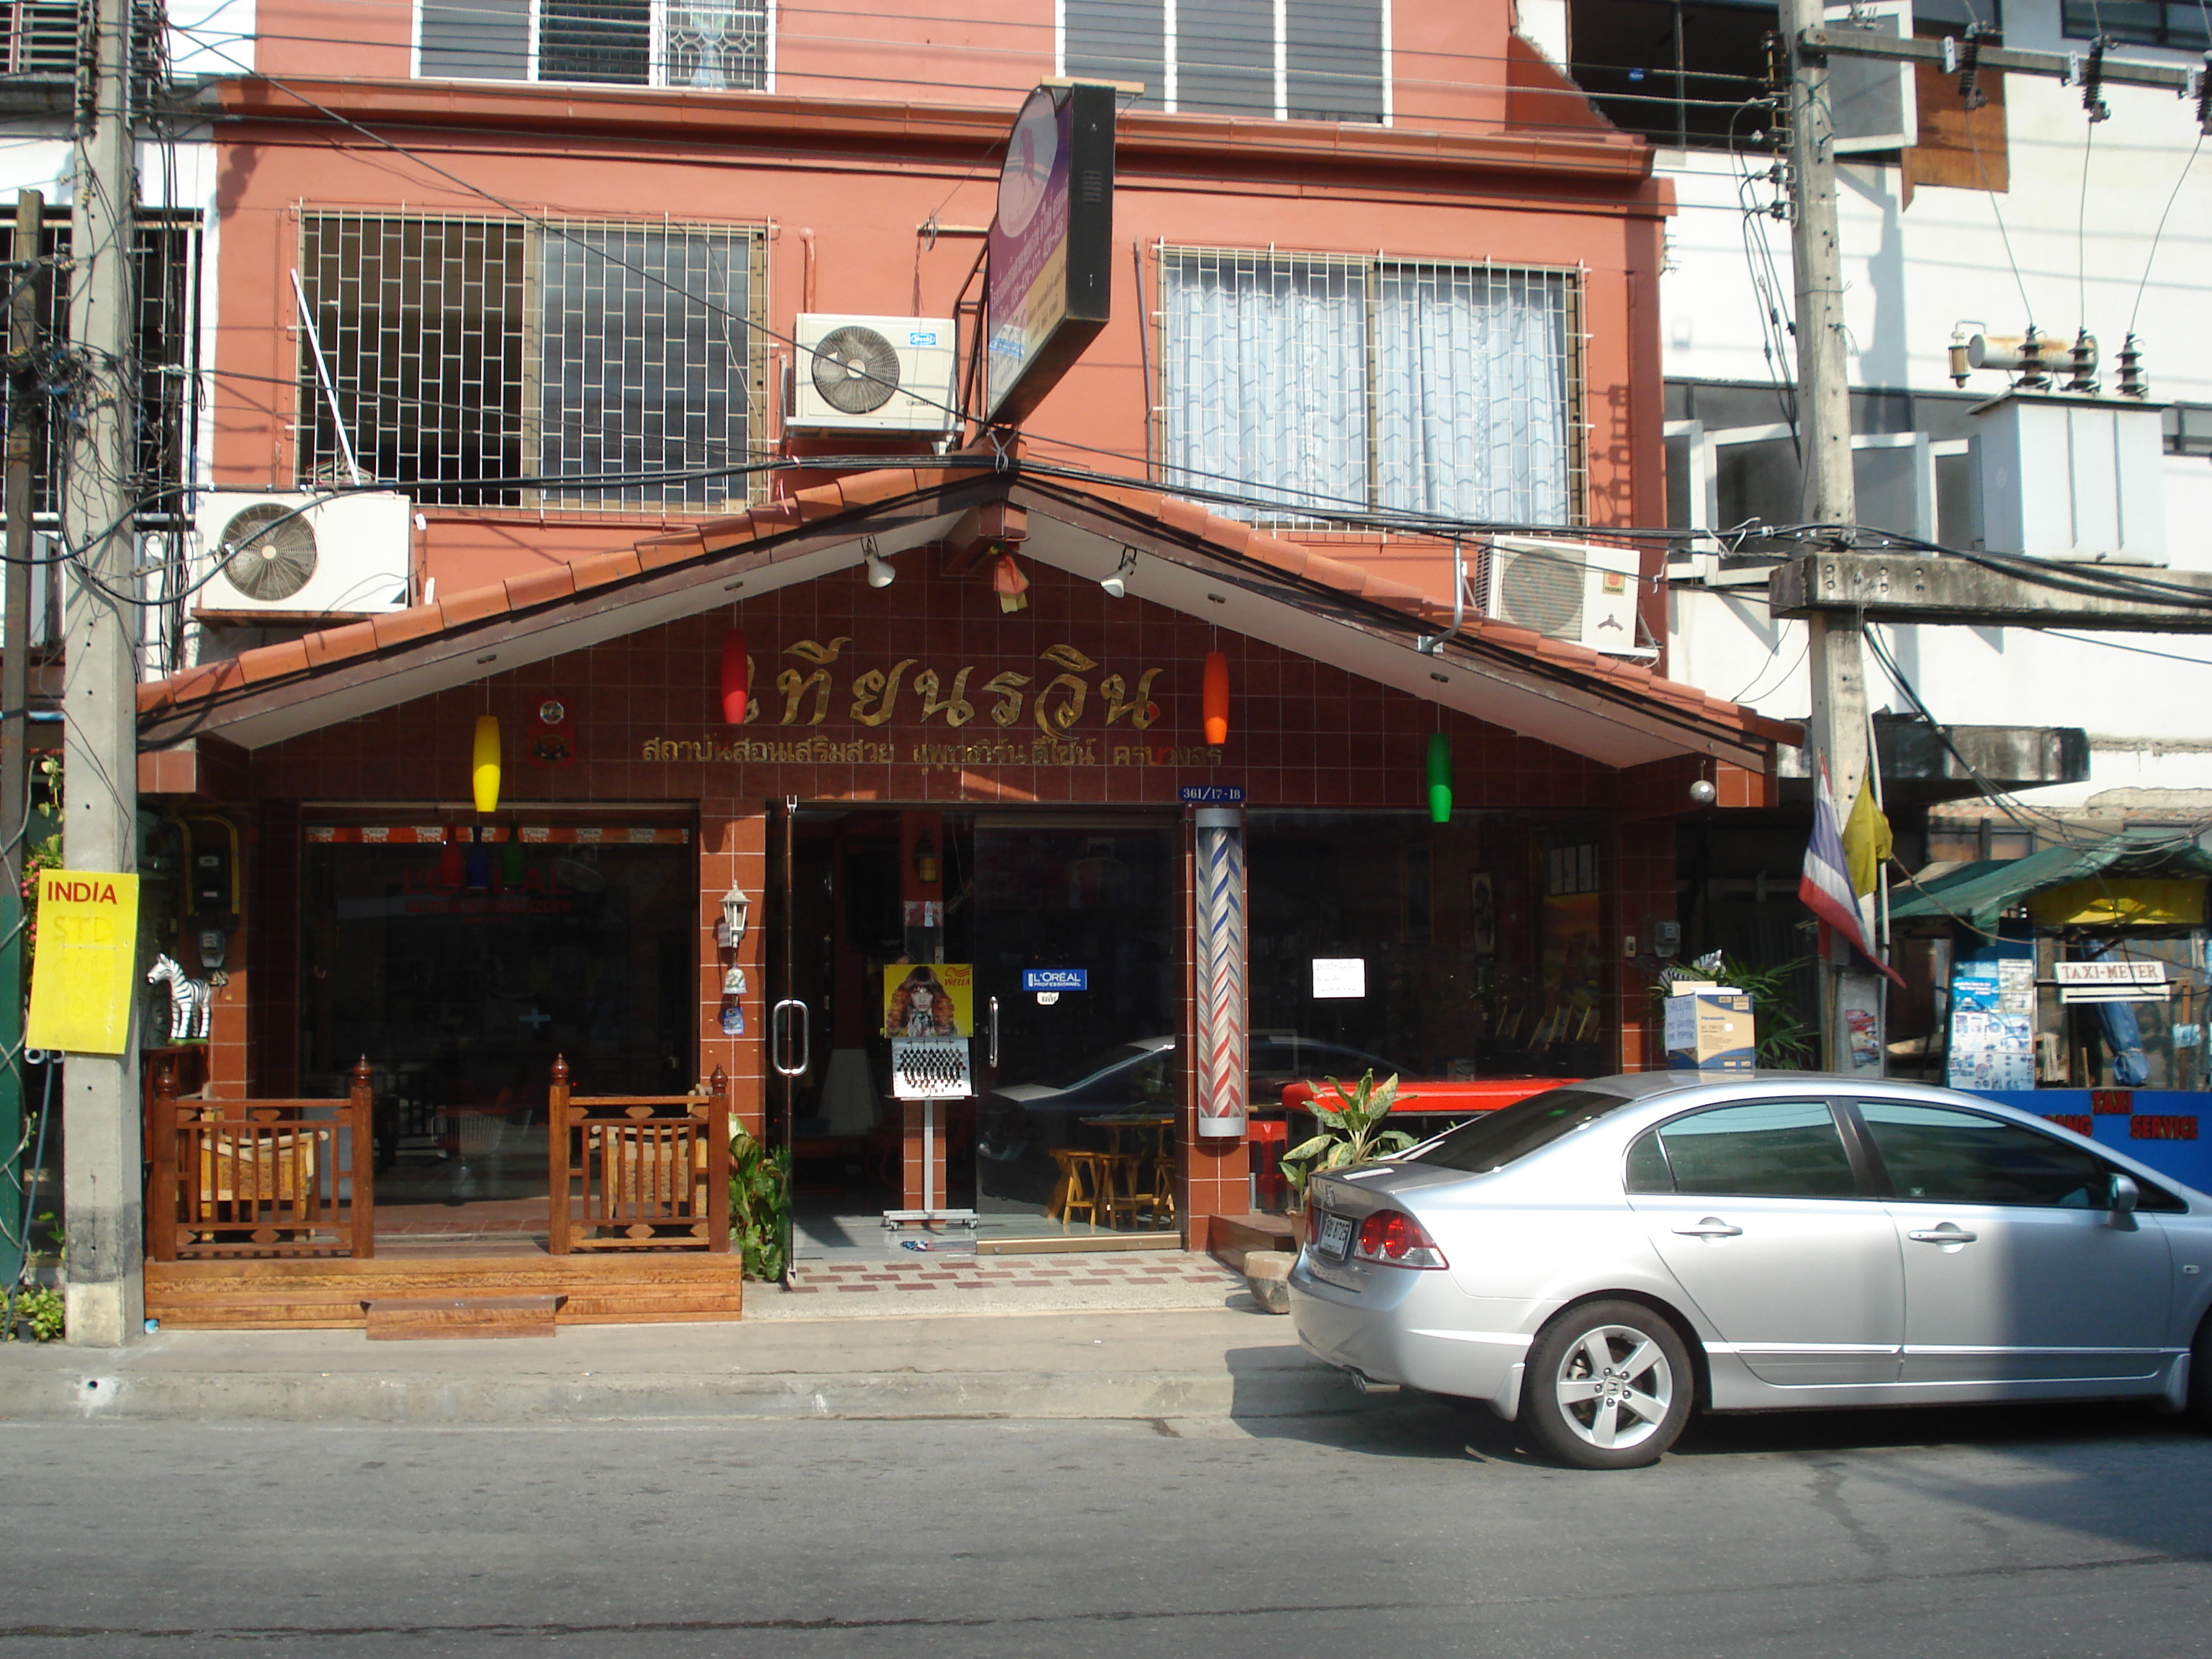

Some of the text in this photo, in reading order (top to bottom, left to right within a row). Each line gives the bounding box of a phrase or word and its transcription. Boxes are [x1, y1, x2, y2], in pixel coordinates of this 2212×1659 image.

[1183, 786, 1241, 800] 361/17-18
[48, 881, 117, 904] INDIA
[1033, 972, 1081, 982] L'ORÉAL
[2062, 964, 2159, 980] TAXI-METER
[2092, 1090, 2133, 1115] TAXI
[2130, 1116, 2198, 1139] SERVICE
